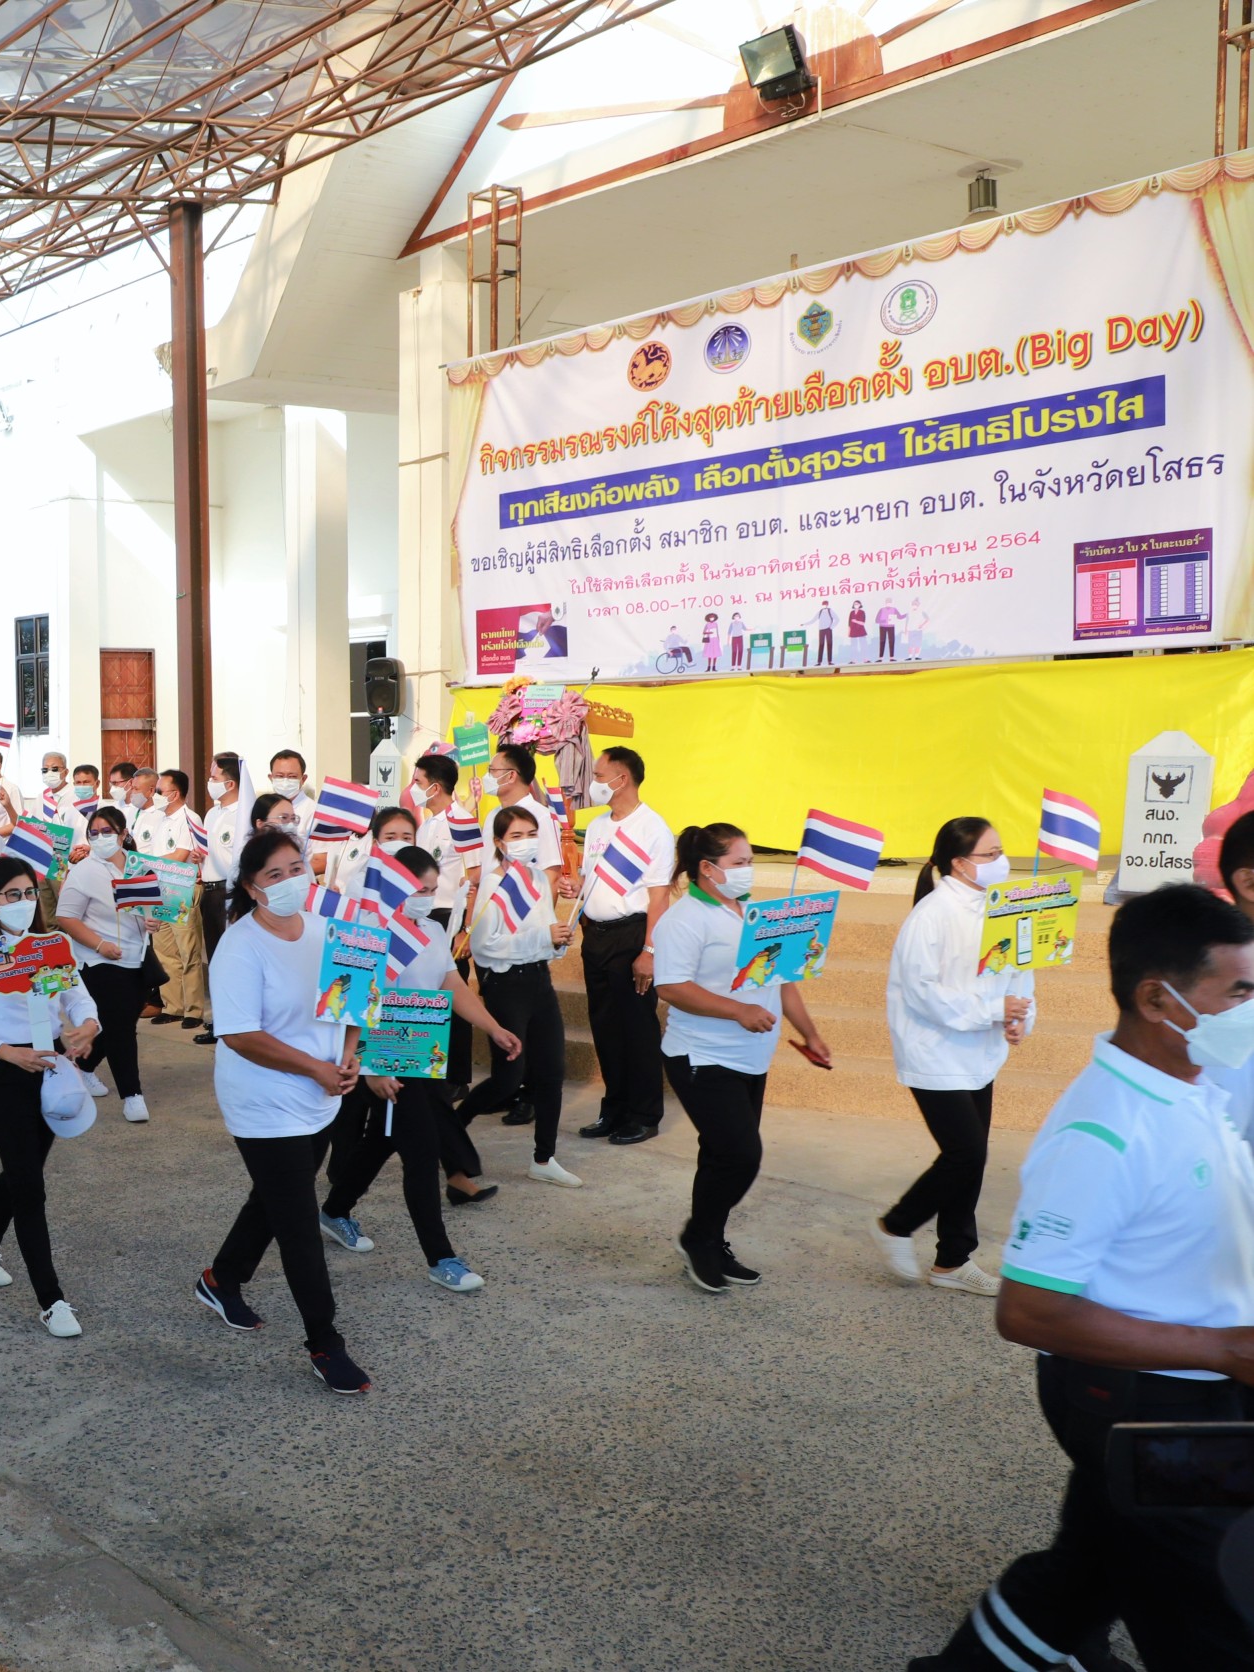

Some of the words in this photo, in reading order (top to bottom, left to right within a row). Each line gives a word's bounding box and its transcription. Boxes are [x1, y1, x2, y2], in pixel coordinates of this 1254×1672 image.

[480, 340, 911, 475] กิจกรรมรณรงค์โค้งสุดท้ายเลือกตั้ง
[1106, 299, 1204, 354] Day)
[509, 475, 680, 525] ทุกเสียงคือพลัง
[695, 438, 886, 493] เลือกตั้งสุจริต
[899, 390, 1145, 458] ใช้สิทธิโปร่งใส
[471, 518, 652, 574] ขอเชิญผู้มีสิทธิเลือกตั้ง
[659, 519, 728, 549] สมาชิก
[736, 516, 789, 539] อบต.
[799, 497, 909, 531] และนายก
[919, 487, 984, 515] อบต.
[994, 446, 1225, 505] ในจังหวัดยโสธร
[569, 562, 695, 595] ไปใช้สิทธิเลือกตั้ง
[700, 549, 822, 582] ในวันอาทิตย์ที่
[828, 553, 851, 568] 28
[859, 537, 978, 568] พฤศจิกายน
[986, 530, 1042, 549] 2564
[1117, 545, 1125, 554] 2
[1126, 541, 1138, 552] ใบ
[587, 605, 620, 618] เวลา
[730, 593, 747, 606] น.
[754, 590, 773, 603] ณ
[779, 558, 1014, 600] หน่วยเลือกตั้งที่ท่านมีชื่อ
[1142, 832, 1178, 845] กกต.
[1145, 808, 1179, 821] สนง.
[1125, 850, 1192, 869] จว.ยโสธร
